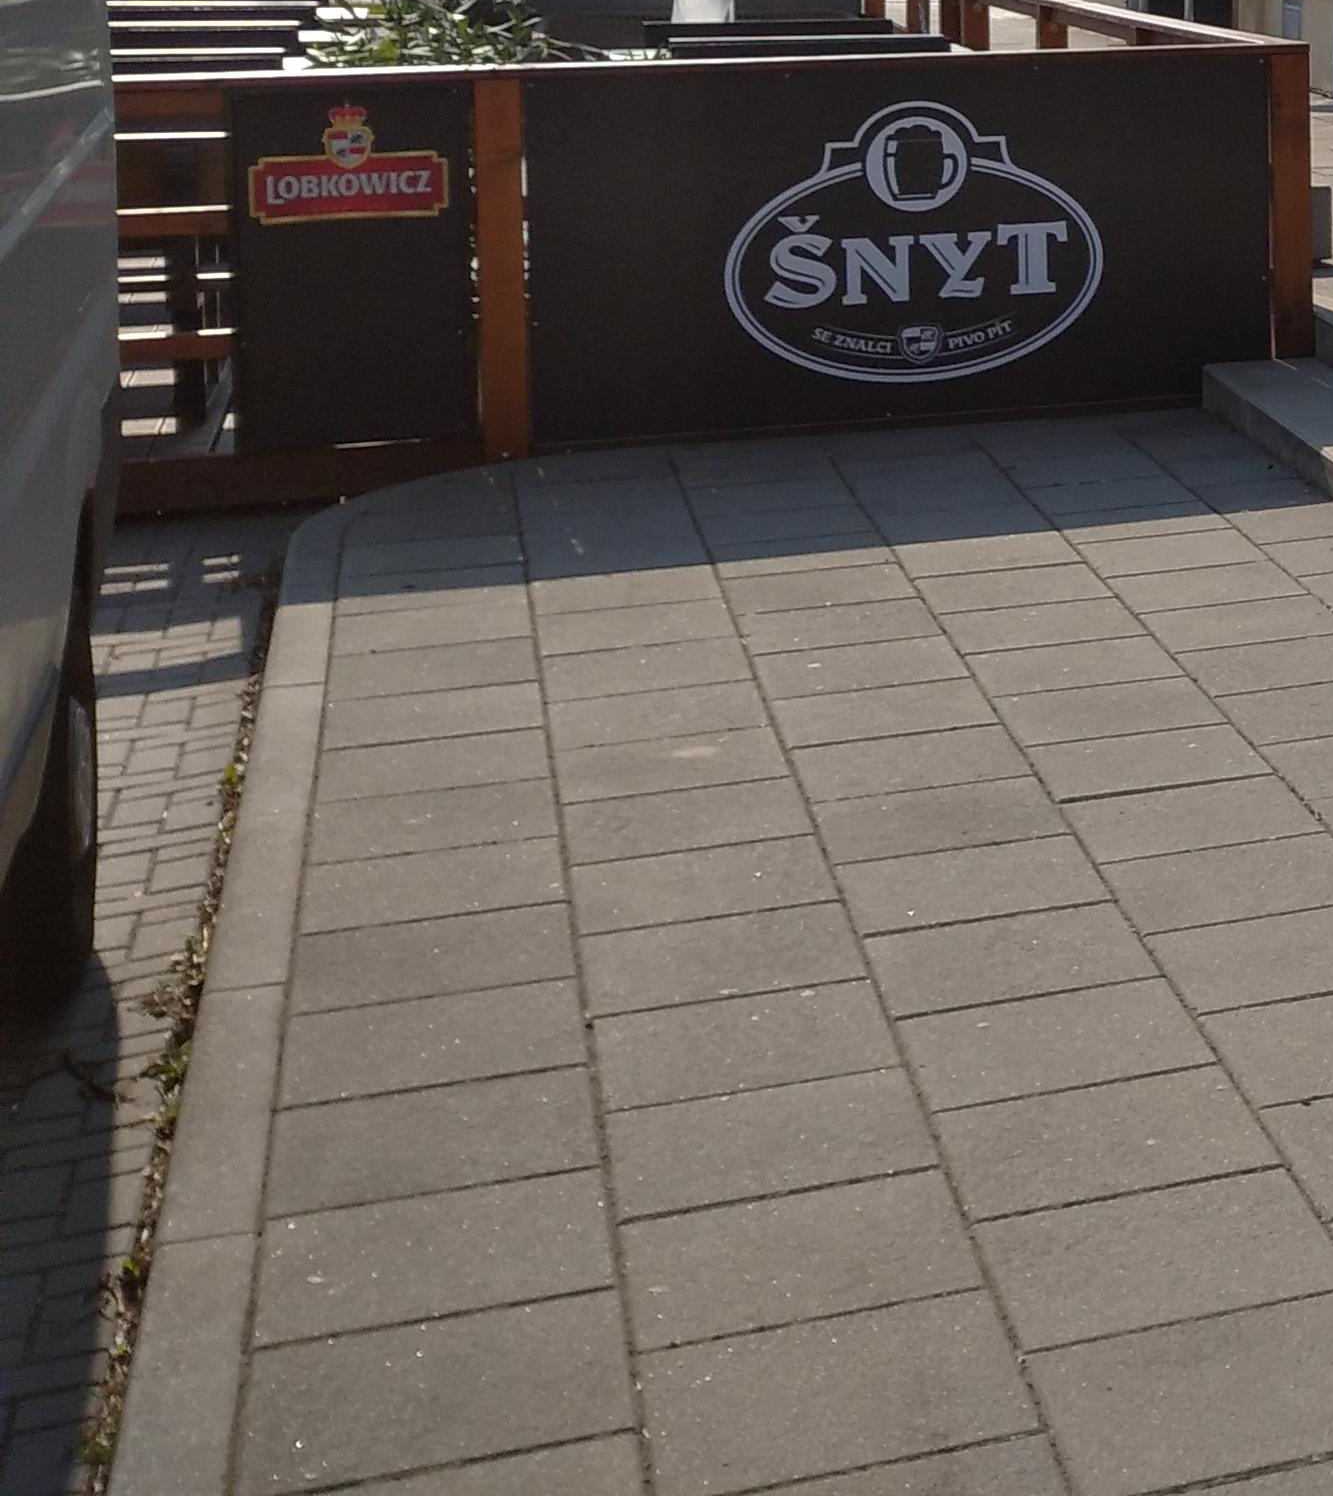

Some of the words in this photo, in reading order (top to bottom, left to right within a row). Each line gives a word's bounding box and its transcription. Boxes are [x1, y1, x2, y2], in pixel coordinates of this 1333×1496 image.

[265, 169, 433, 206] LOBKOWICZ
[763, 213, 1069, 310] ŠNYT
[811, 327, 831, 343] SE
[834, 335, 894, 355] ZNALCI
[947, 333, 986, 350] PIVO
[988, 319, 1014, 340] PÍT
